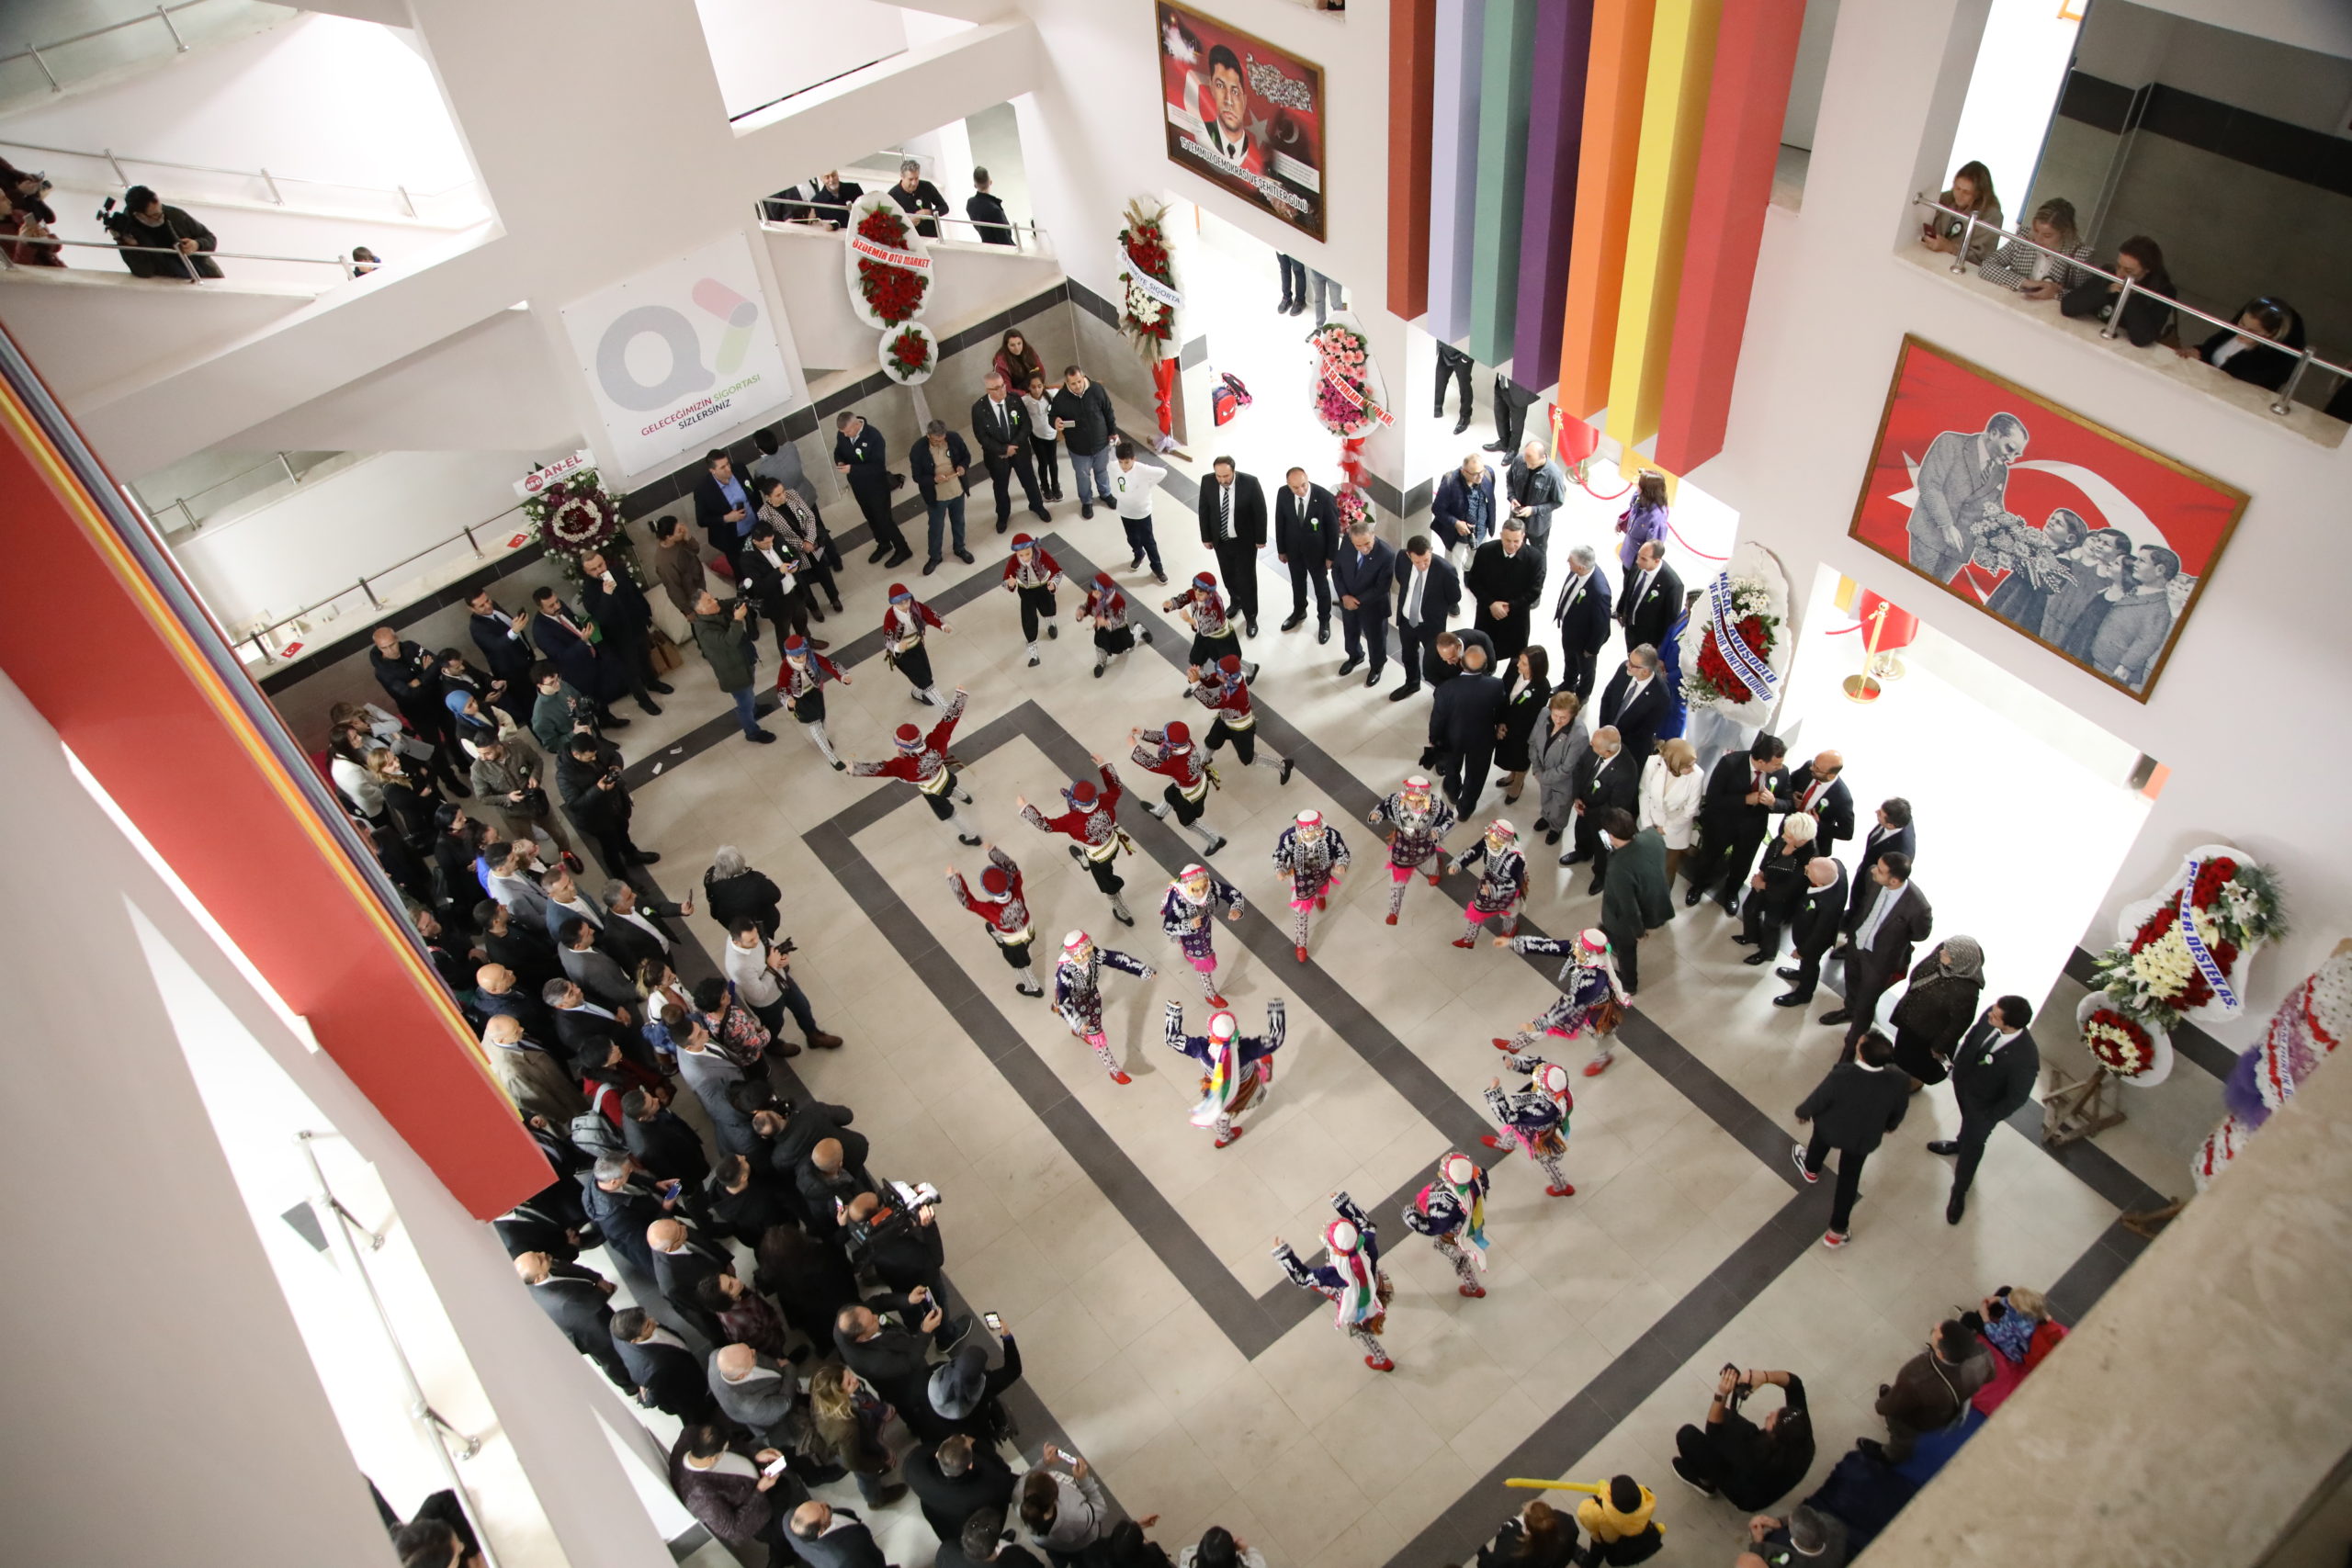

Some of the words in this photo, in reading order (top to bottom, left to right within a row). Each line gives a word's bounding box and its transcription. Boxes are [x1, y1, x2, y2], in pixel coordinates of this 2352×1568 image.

[1187, 140, 1213, 165] TEMMUZ
[1288, 190, 1308, 213] GÜNÜ
[852, 238, 888, 260] ÖZDEMİR
[888, 254, 903, 264] OTO
[903, 255, 930, 268] MARKET
[678, 399, 731, 430] SİZLERSİNİZ
[545, 456, 582, 479] AN-EL
[1709, 581, 1718, 593] VE
[1745, 671, 1773, 702] KURULU
[2185, 935, 2225, 991] DESTEK
